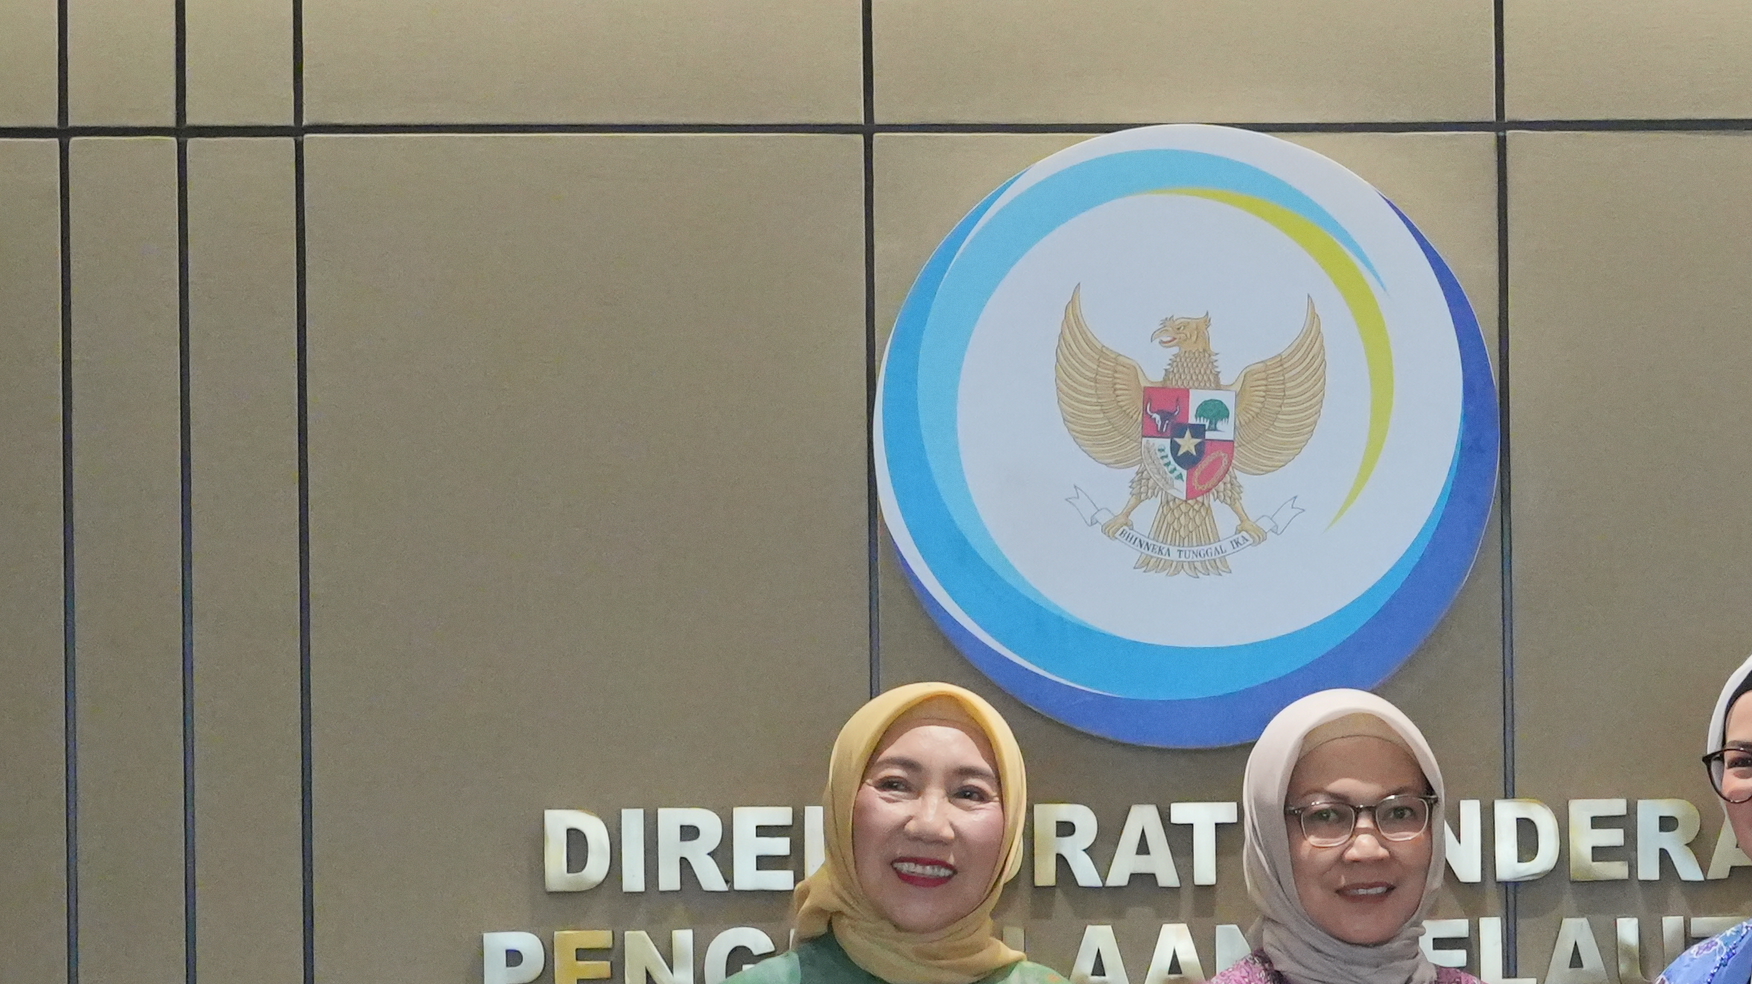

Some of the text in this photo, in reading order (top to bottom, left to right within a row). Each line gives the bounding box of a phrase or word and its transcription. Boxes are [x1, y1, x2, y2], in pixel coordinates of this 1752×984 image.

[1119, 527, 1250, 560] BHINNEKA TUNGGAL IKA
